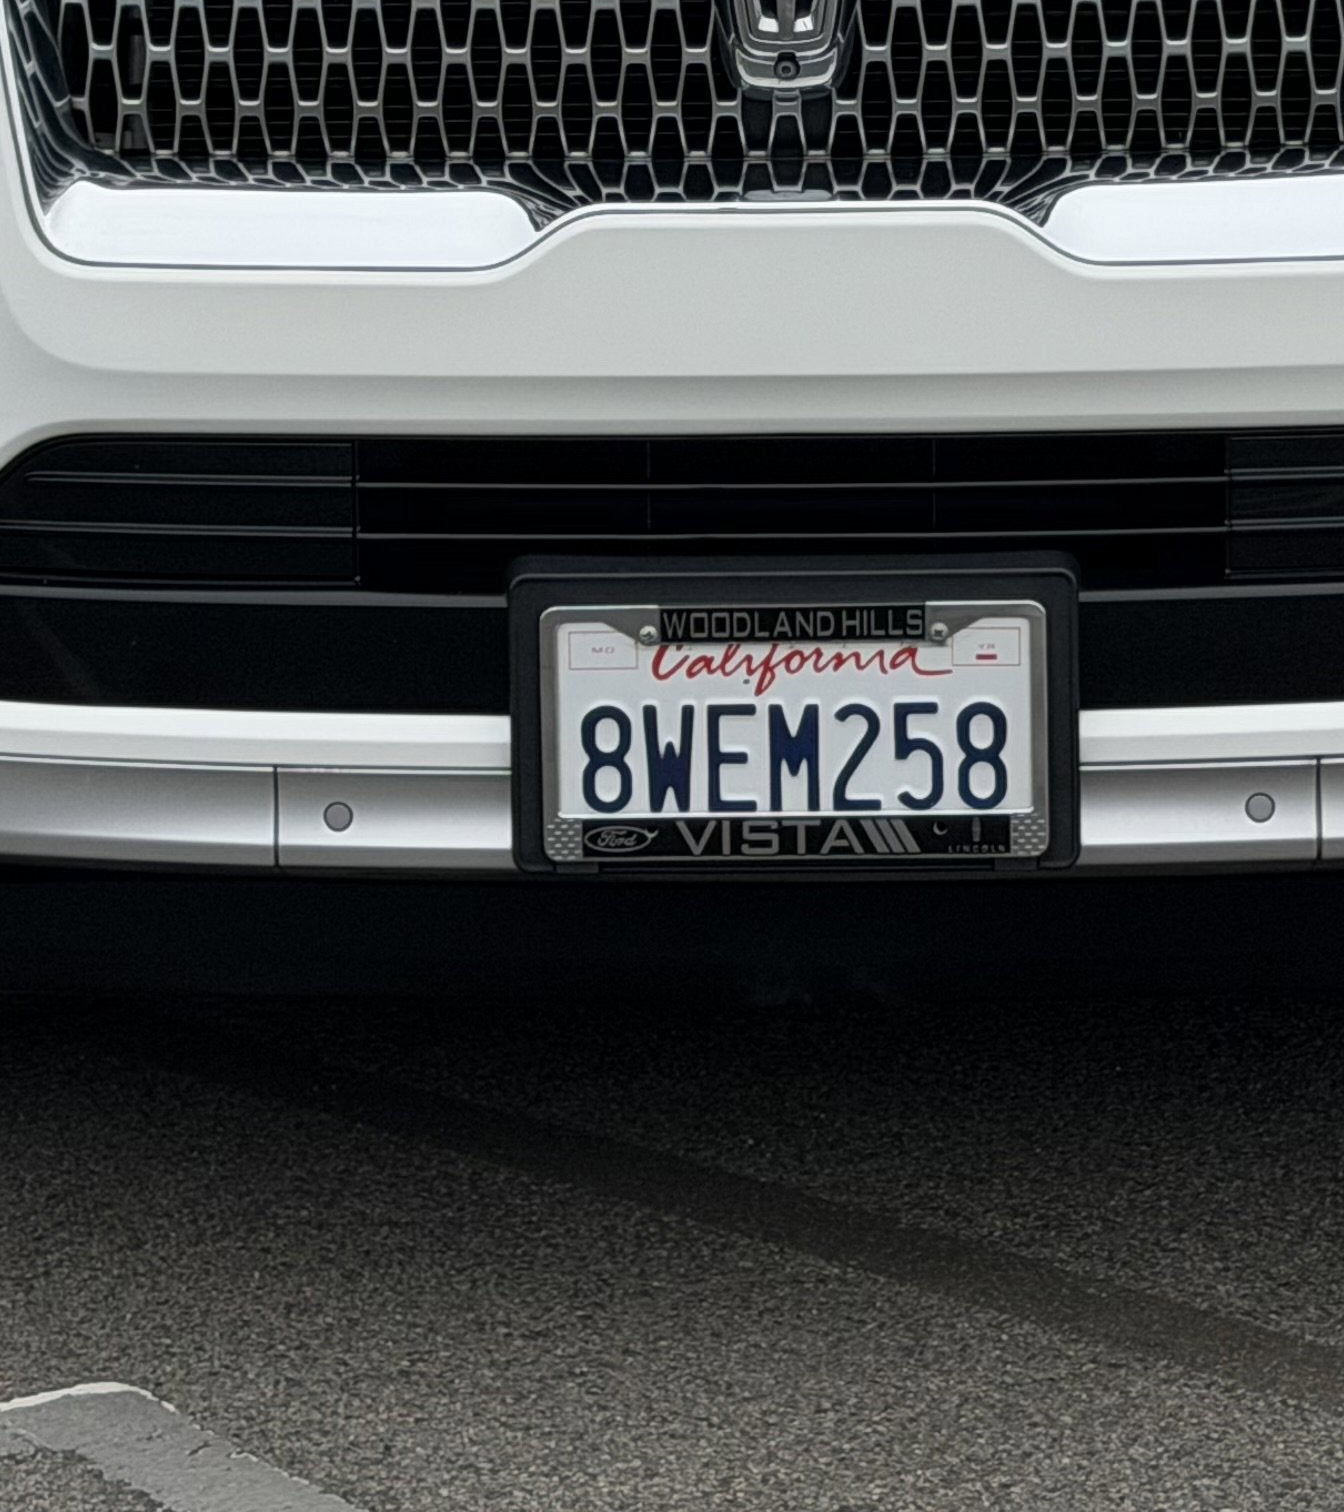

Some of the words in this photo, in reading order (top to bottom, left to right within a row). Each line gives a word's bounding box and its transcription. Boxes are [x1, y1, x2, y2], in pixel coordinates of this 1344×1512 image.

[662, 609, 835, 640] WOODLAND
[840, 608, 924, 638] HILLS
[651, 642, 953, 697] California
[579, 699, 1008, 814] 8WEM258
[596, 830, 638, 847] Ford
[674, 819, 864, 857] VISTA
